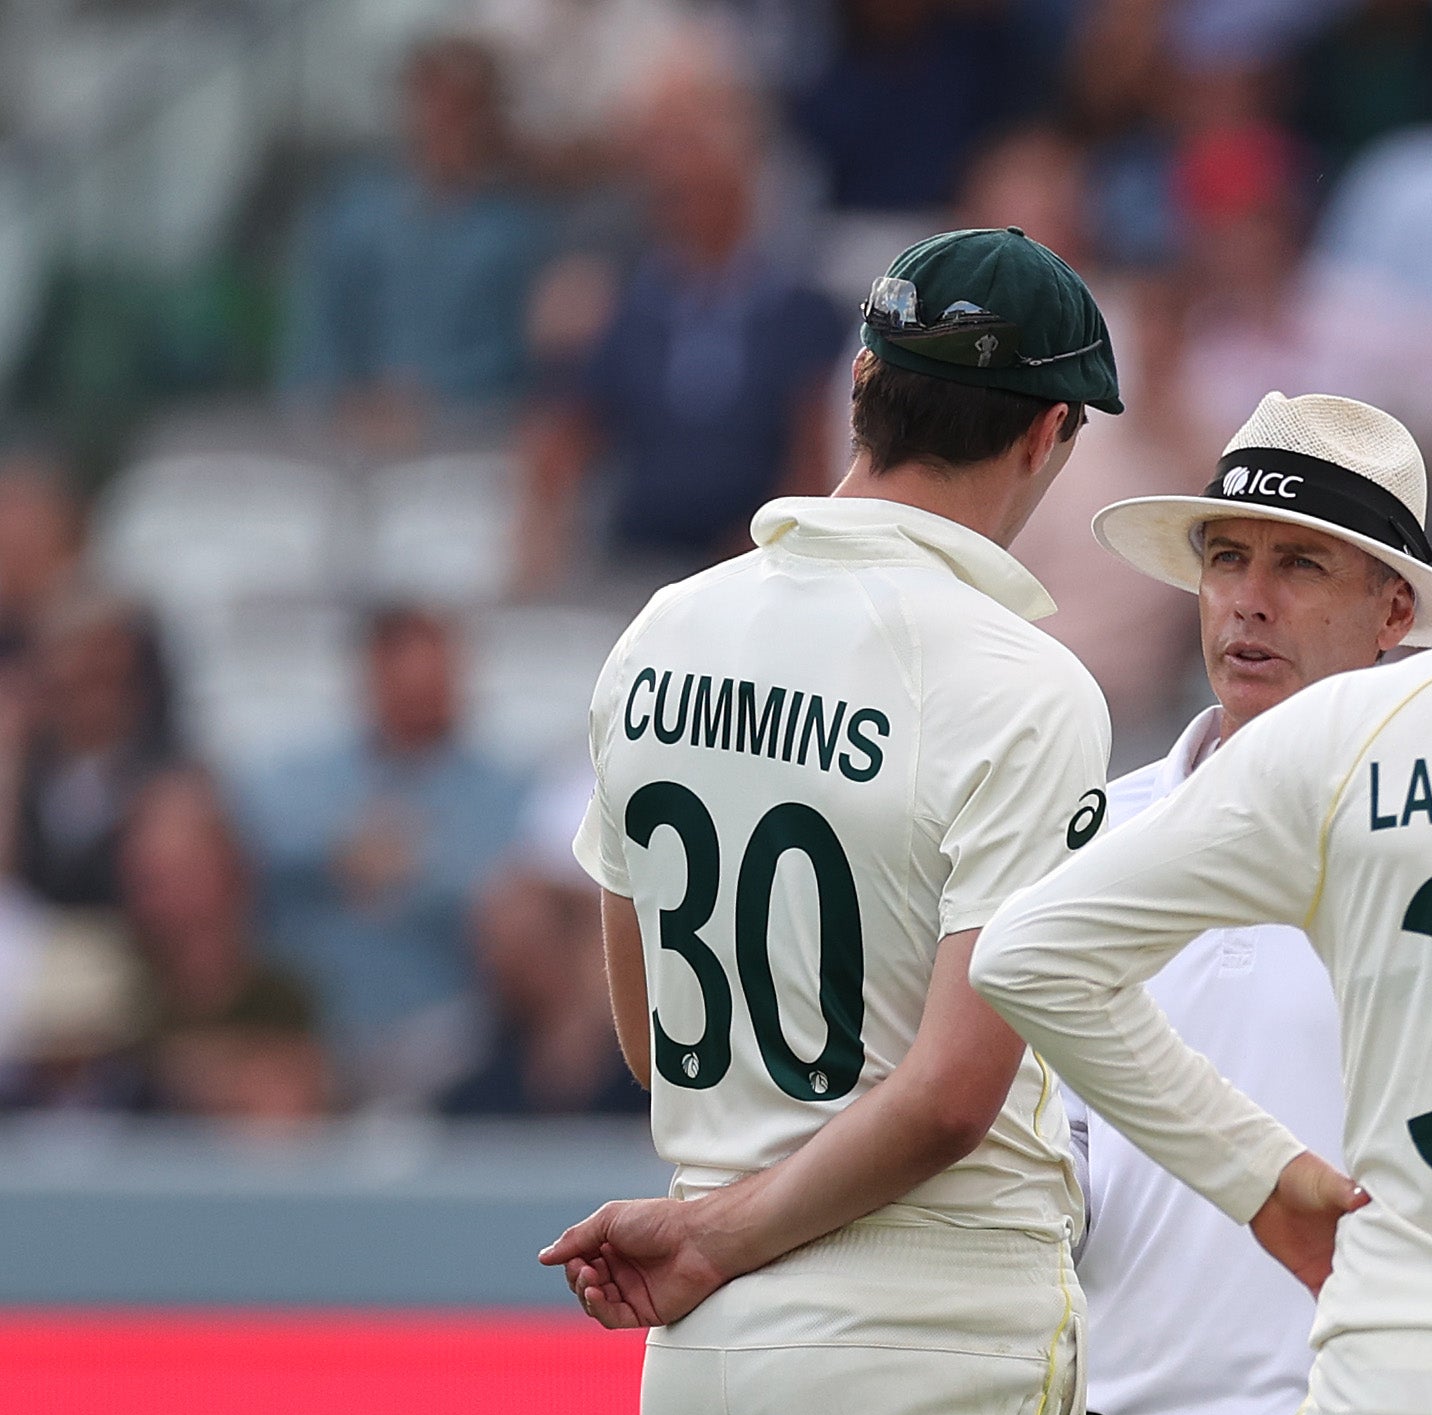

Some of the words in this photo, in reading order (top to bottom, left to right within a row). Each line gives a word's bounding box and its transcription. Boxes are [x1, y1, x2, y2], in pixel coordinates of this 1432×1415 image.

[1248, 469, 1304, 498] ICC
[623, 666, 891, 782] CUMMINS
[624, 780, 866, 1103] 30
